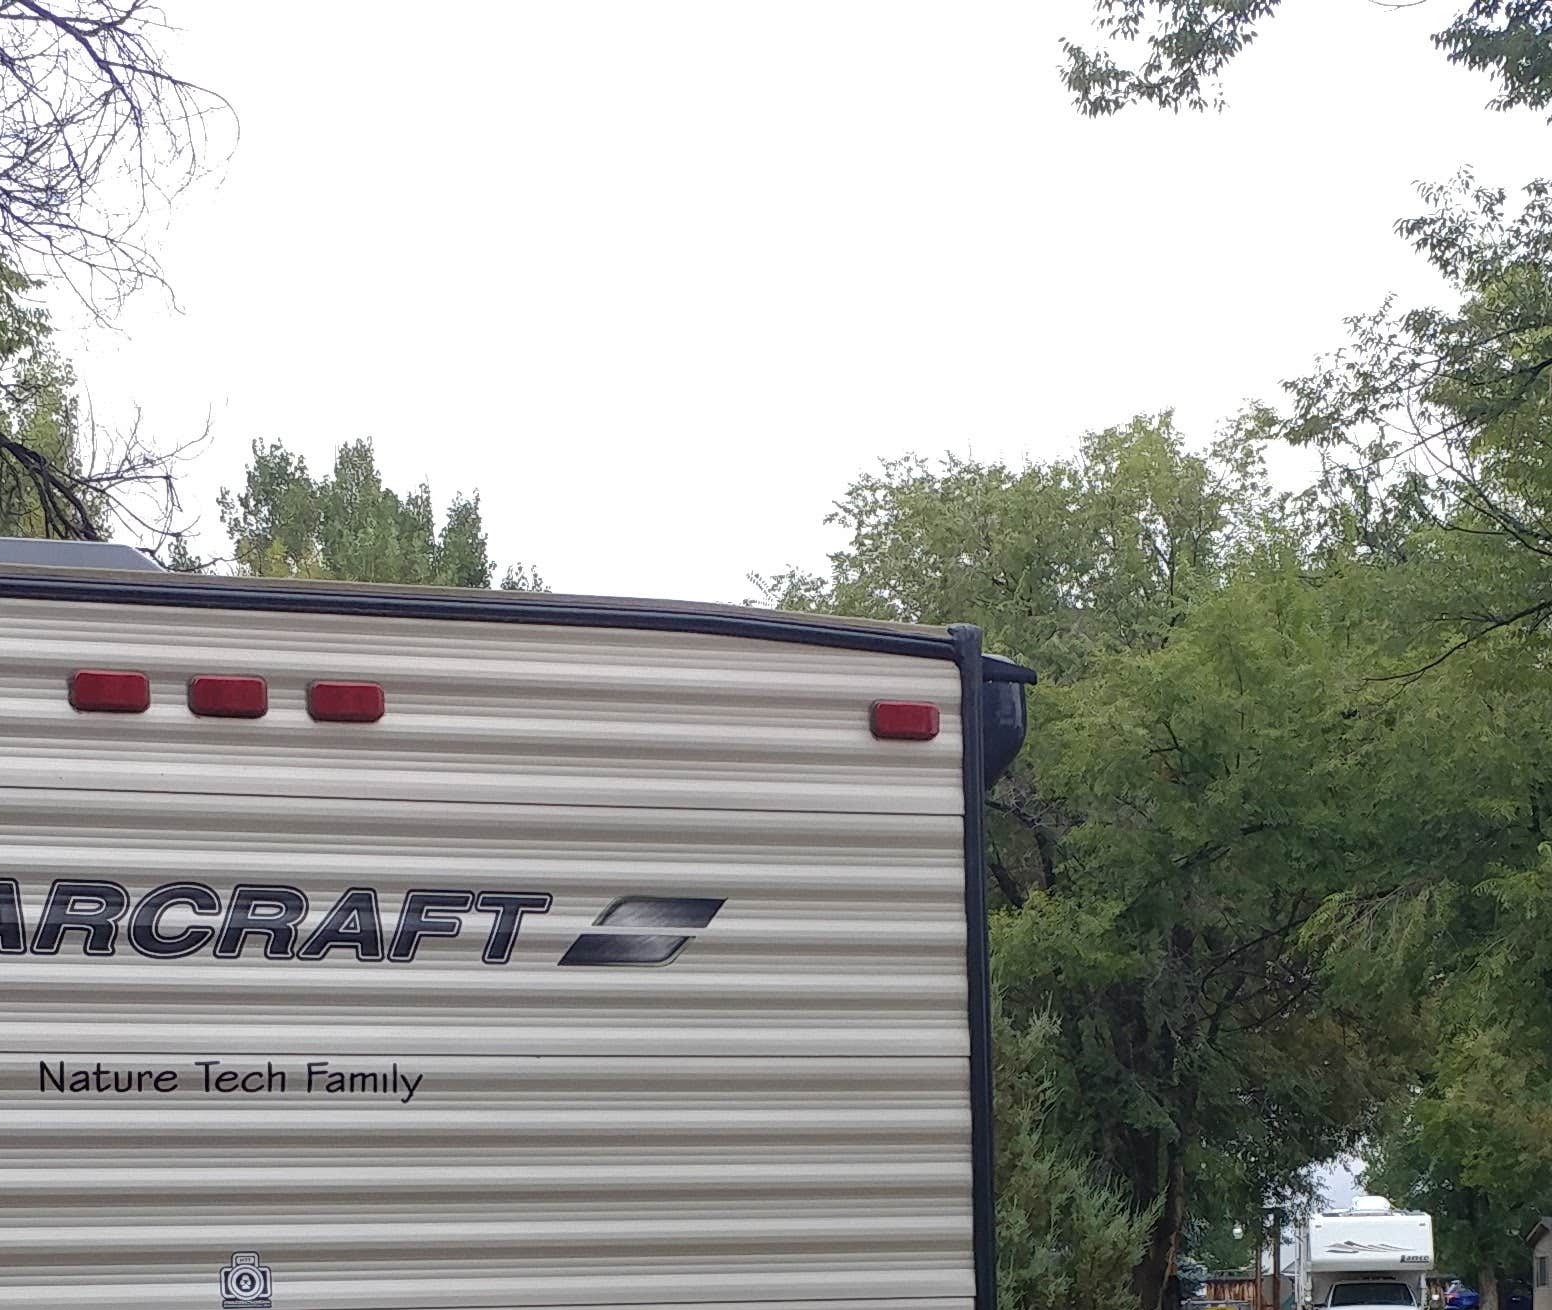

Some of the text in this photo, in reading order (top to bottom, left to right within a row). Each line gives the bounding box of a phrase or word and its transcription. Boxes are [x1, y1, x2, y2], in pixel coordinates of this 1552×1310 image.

[38, 1060, 423, 1103] Nature Tech Family
